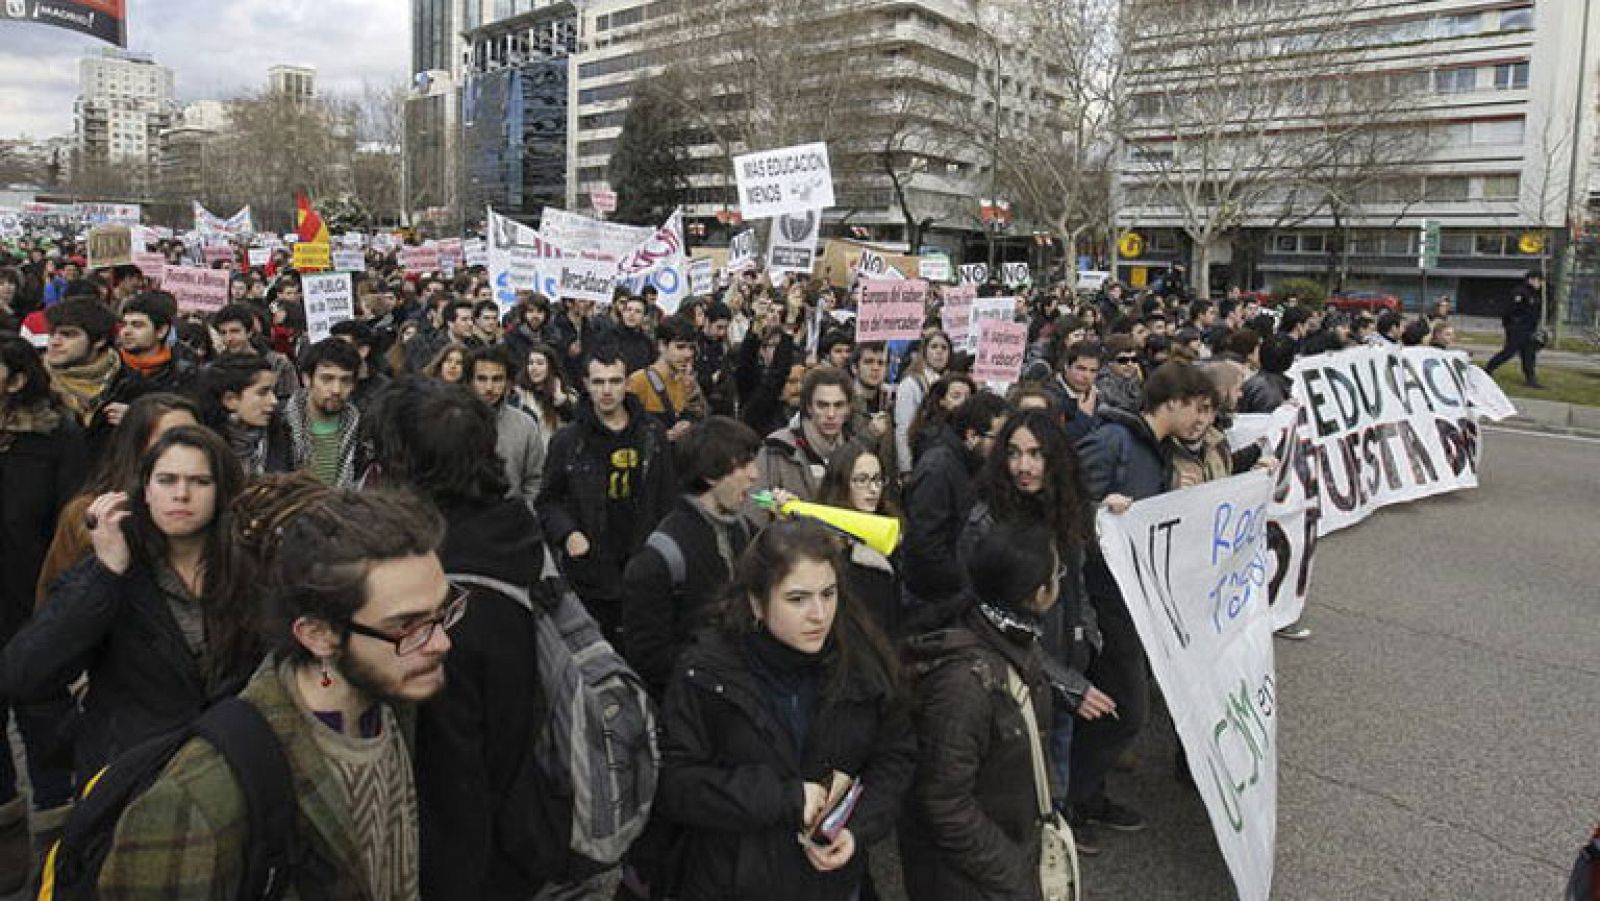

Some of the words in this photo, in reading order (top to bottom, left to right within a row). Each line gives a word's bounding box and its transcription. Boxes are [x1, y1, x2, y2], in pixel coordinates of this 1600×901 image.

[745, 182, 782, 204] MENOS
[860, 251, 883, 274] NO
[960, 264, 987, 282] NO
[1004, 264, 1028, 282] NO
[891, 286, 902, 303] del
[870, 314, 882, 332] del
